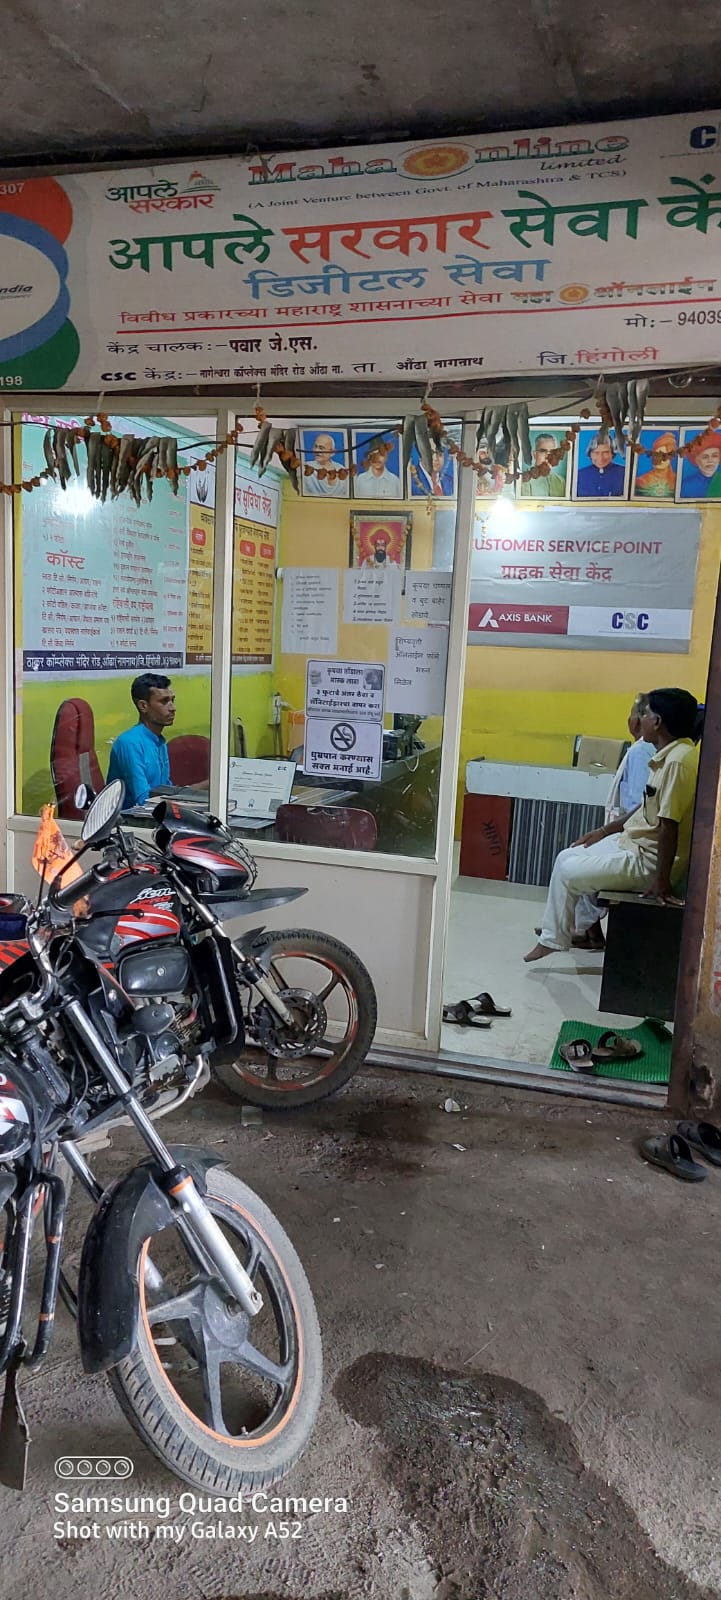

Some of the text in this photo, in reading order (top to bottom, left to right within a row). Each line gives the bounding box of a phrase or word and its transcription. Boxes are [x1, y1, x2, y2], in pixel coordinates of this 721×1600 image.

[248, 156, 397, 186] Maha
[540, 154, 628, 171] limited
[105, 180, 178, 203] आपले
[268, 199, 298, 208] Joint
[301, 194, 351, 204] Venture
[355, 188, 410, 200] between
[457, 182, 473, 190] of
[476, 175, 564, 189] Maharashtra
[568, 173, 581, 181] &
[128, 194, 215, 214] सरकार
[108, 213, 274, 273] आपले
[281, 210, 494, 264] सरकार
[500, 190, 649, 248] सेवा
[242, 254, 552, 299] डिजीटल सेवा
[118, 310, 177, 324] विवीध
[182, 307, 268, 321] प्रकारच्या
[275, 303, 343, 318] महाराष्ट्र
[349, 295, 453, 313] शासनाच्या
[459, 290, 504, 305] सेवा
[106, 341, 139, 354] केंद्र
[433, 357, 484, 368] नागनाथ
[474, 537, 663, 554] USTOMER SERVICE POINT
[501, 561, 614, 582] ग्राहक सेवा केंद्र
[499, 613, 553, 624] AXIS BANK
[611, 612, 649, 630] CSC
[333, 763, 353, 774] मनाई
